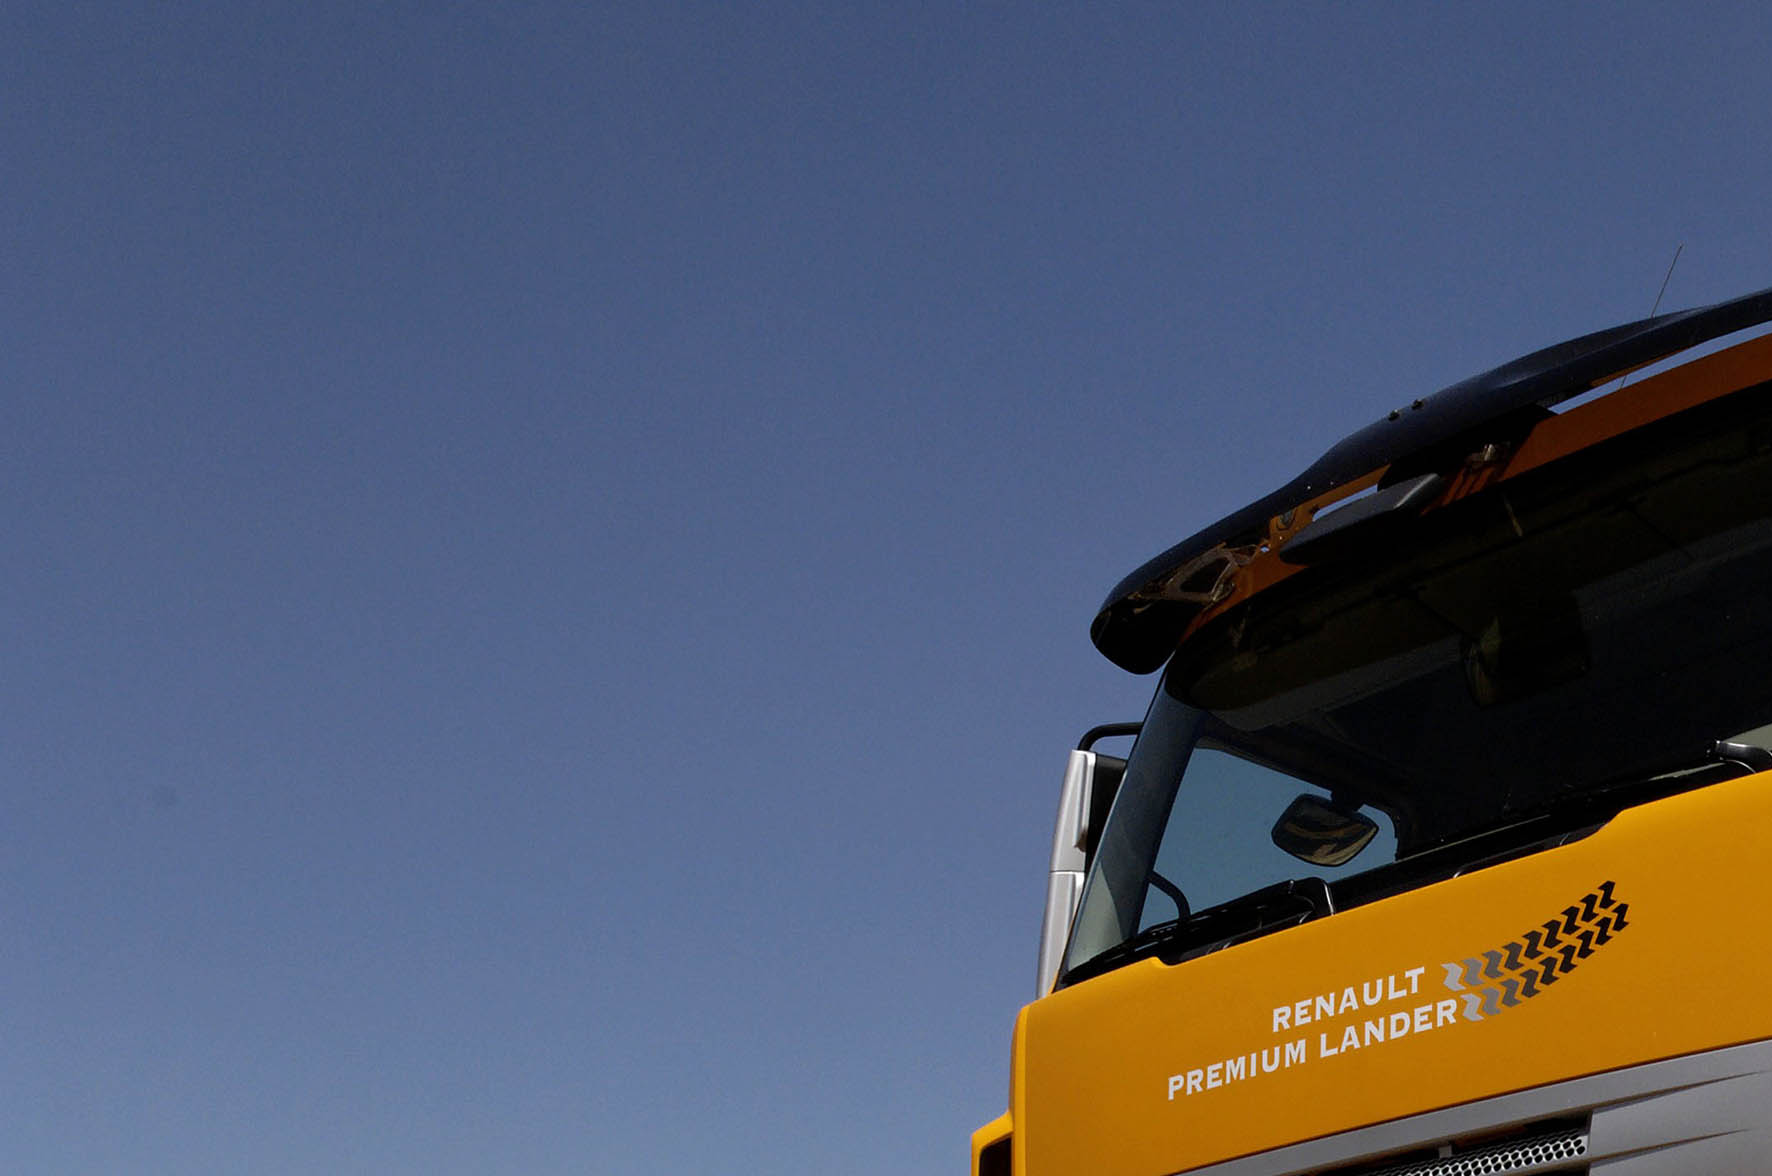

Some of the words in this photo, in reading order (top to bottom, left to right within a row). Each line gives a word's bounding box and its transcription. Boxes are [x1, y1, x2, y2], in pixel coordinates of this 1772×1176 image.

[1272, 966, 1426, 1033] RENAULT
[1167, 1039, 1307, 1101] PREMIUM
[1319, 999, 1458, 1058] LANDER
